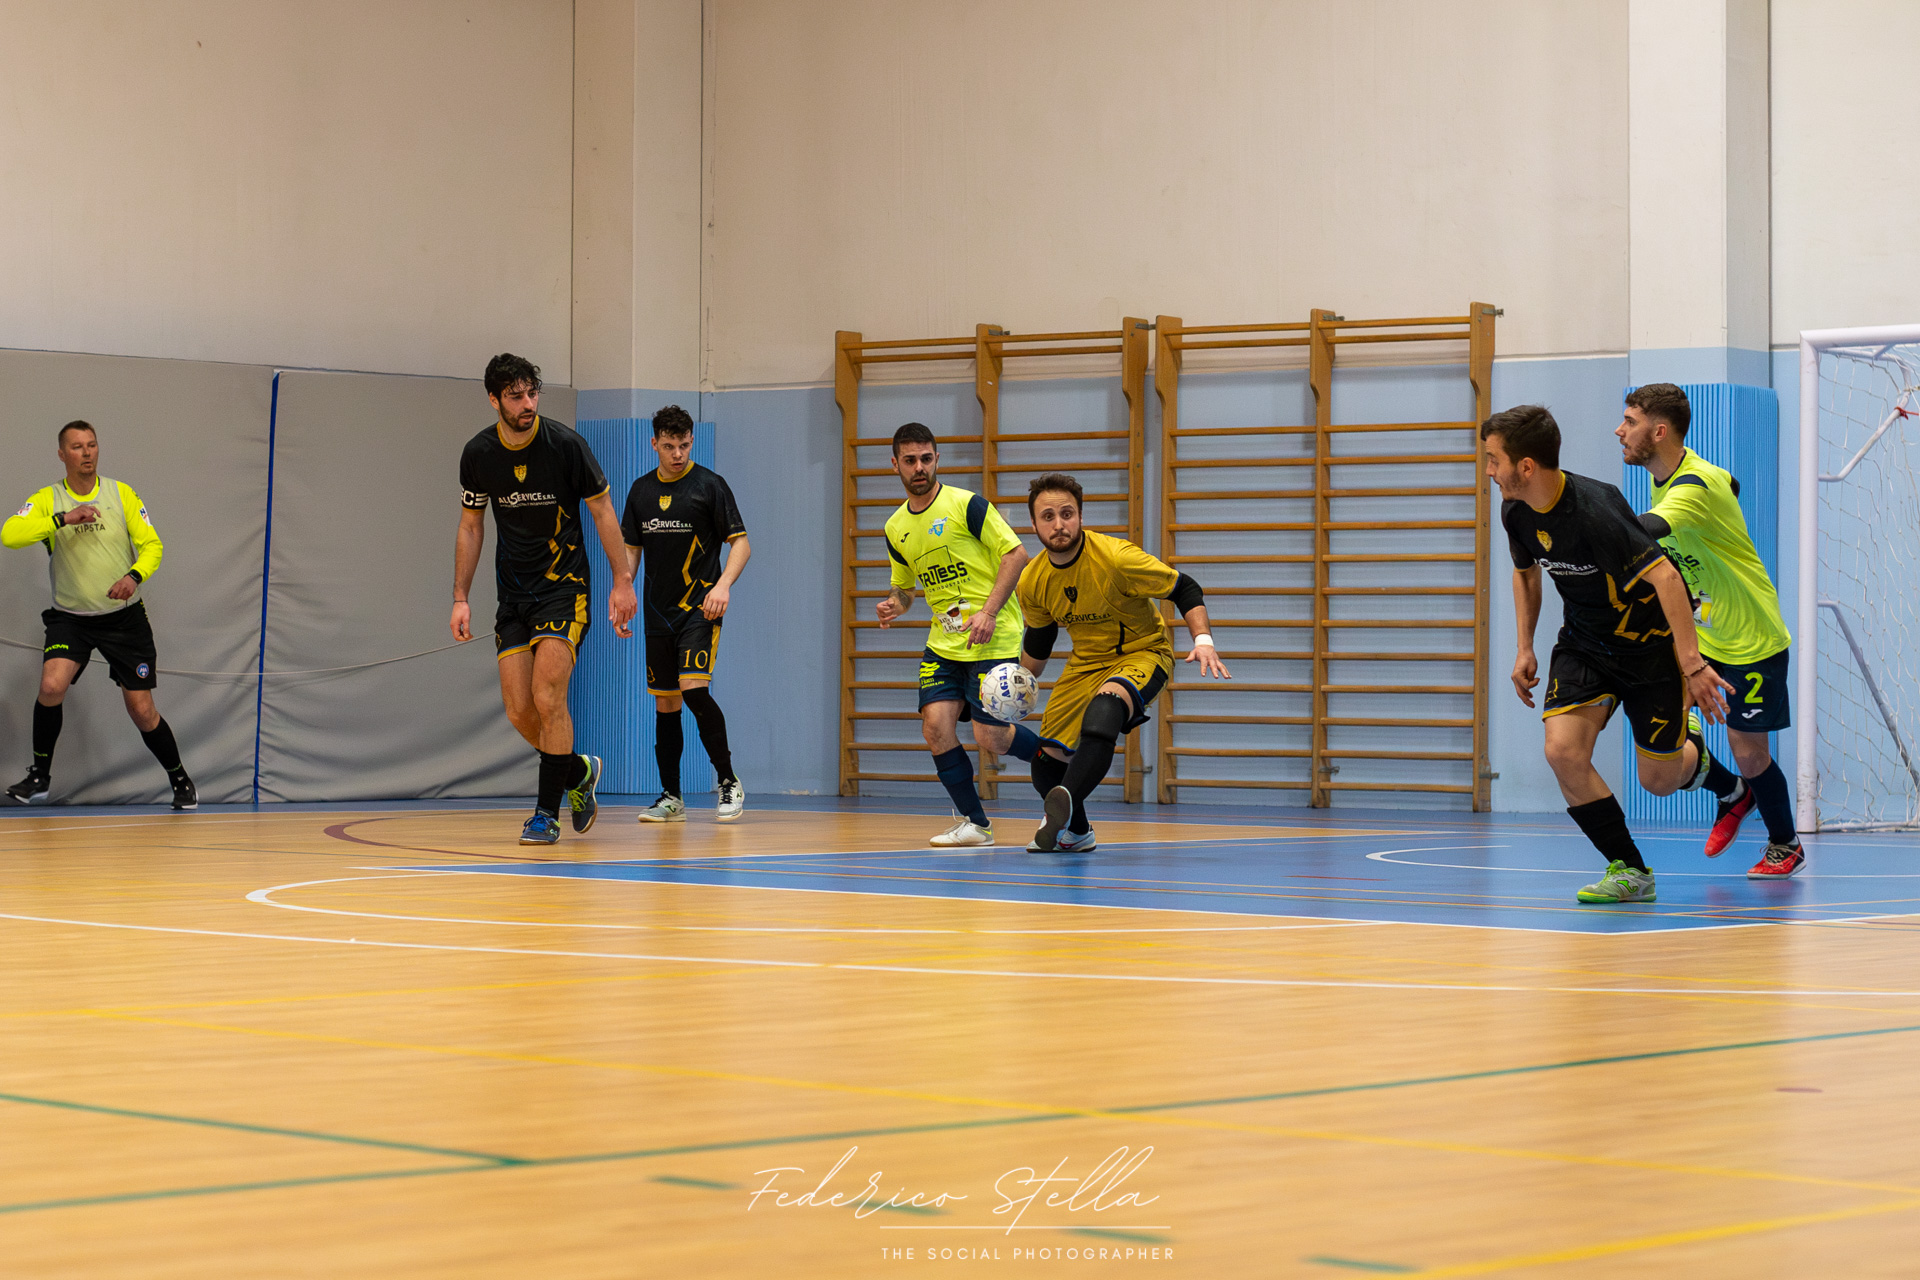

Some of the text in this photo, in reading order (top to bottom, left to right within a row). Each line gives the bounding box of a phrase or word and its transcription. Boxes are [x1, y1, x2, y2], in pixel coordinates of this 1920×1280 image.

[463, 489, 475, 506] C
[74, 523, 106, 534] KIPSTA
[683, 649, 708, 669] 10
[1744, 672, 1763, 704] 2
[1649, 716, 1669, 743] 7
